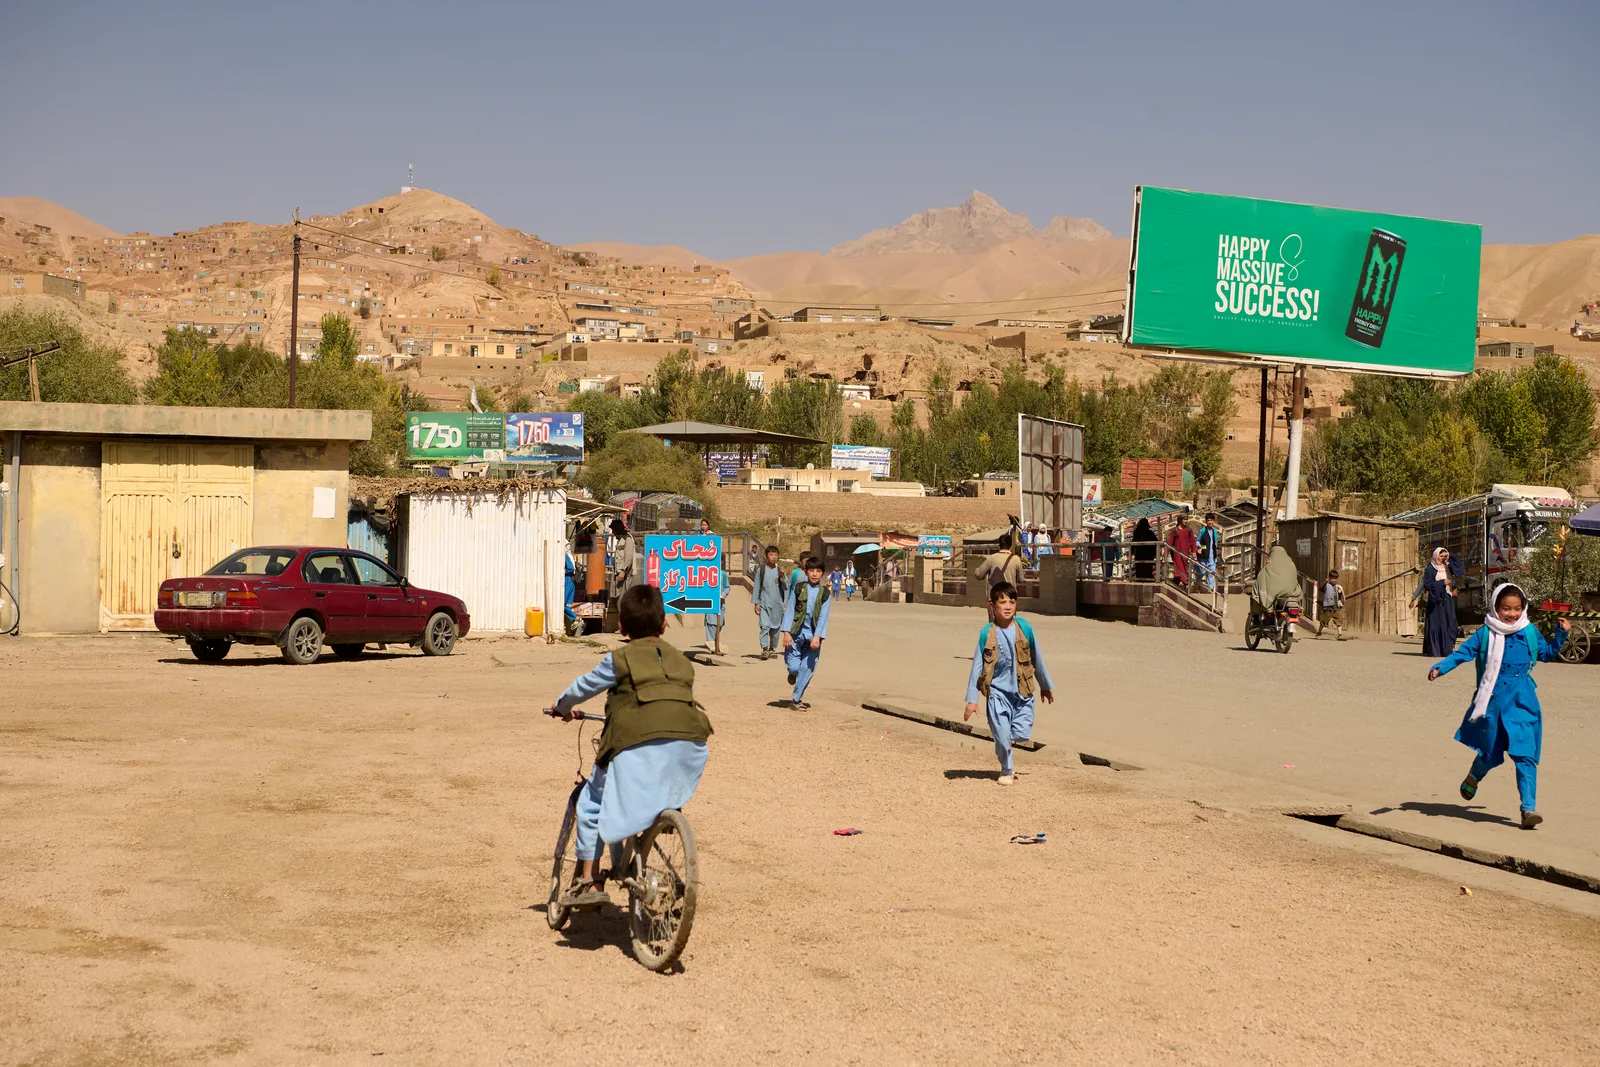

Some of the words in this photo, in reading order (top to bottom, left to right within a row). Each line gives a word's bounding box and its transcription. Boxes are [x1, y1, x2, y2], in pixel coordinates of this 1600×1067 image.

[1218, 234, 1270, 262] HAPPY
[1216, 257, 1285, 286] MASSIVE
[1214, 280, 1320, 321] SUCCESS!
[1355, 306, 1385, 325] HAPPY
[409, 422, 463, 449] 1750
[515, 419, 551, 447] 1750
[663, 538, 718, 560] ضحاک
[661, 568, 680, 592] گاز
[678, 576, 686, 592] و
[687, 565, 719, 588] LPG
